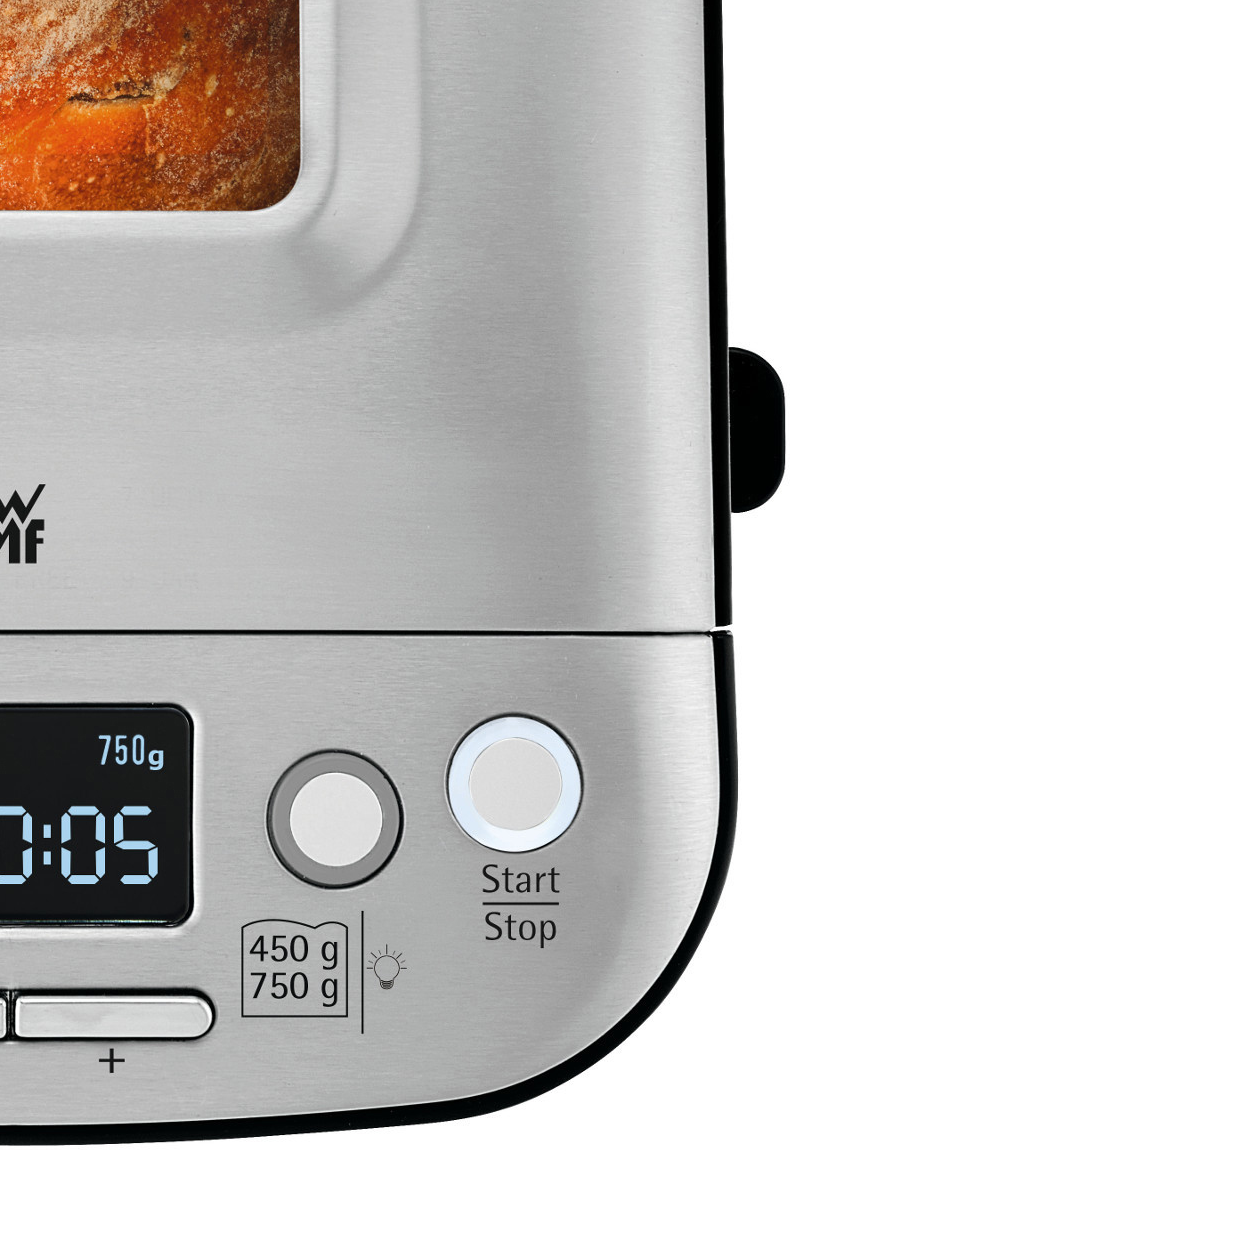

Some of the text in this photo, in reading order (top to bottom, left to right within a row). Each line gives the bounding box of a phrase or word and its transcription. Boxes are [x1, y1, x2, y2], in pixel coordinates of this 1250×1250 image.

[98, 734, 165, 771] 750g
[482, 863, 561, 894] Start
[484, 911, 557, 949] Stop
[249, 934, 339, 970] 450 g
[249, 971, 339, 1008] 750 g
